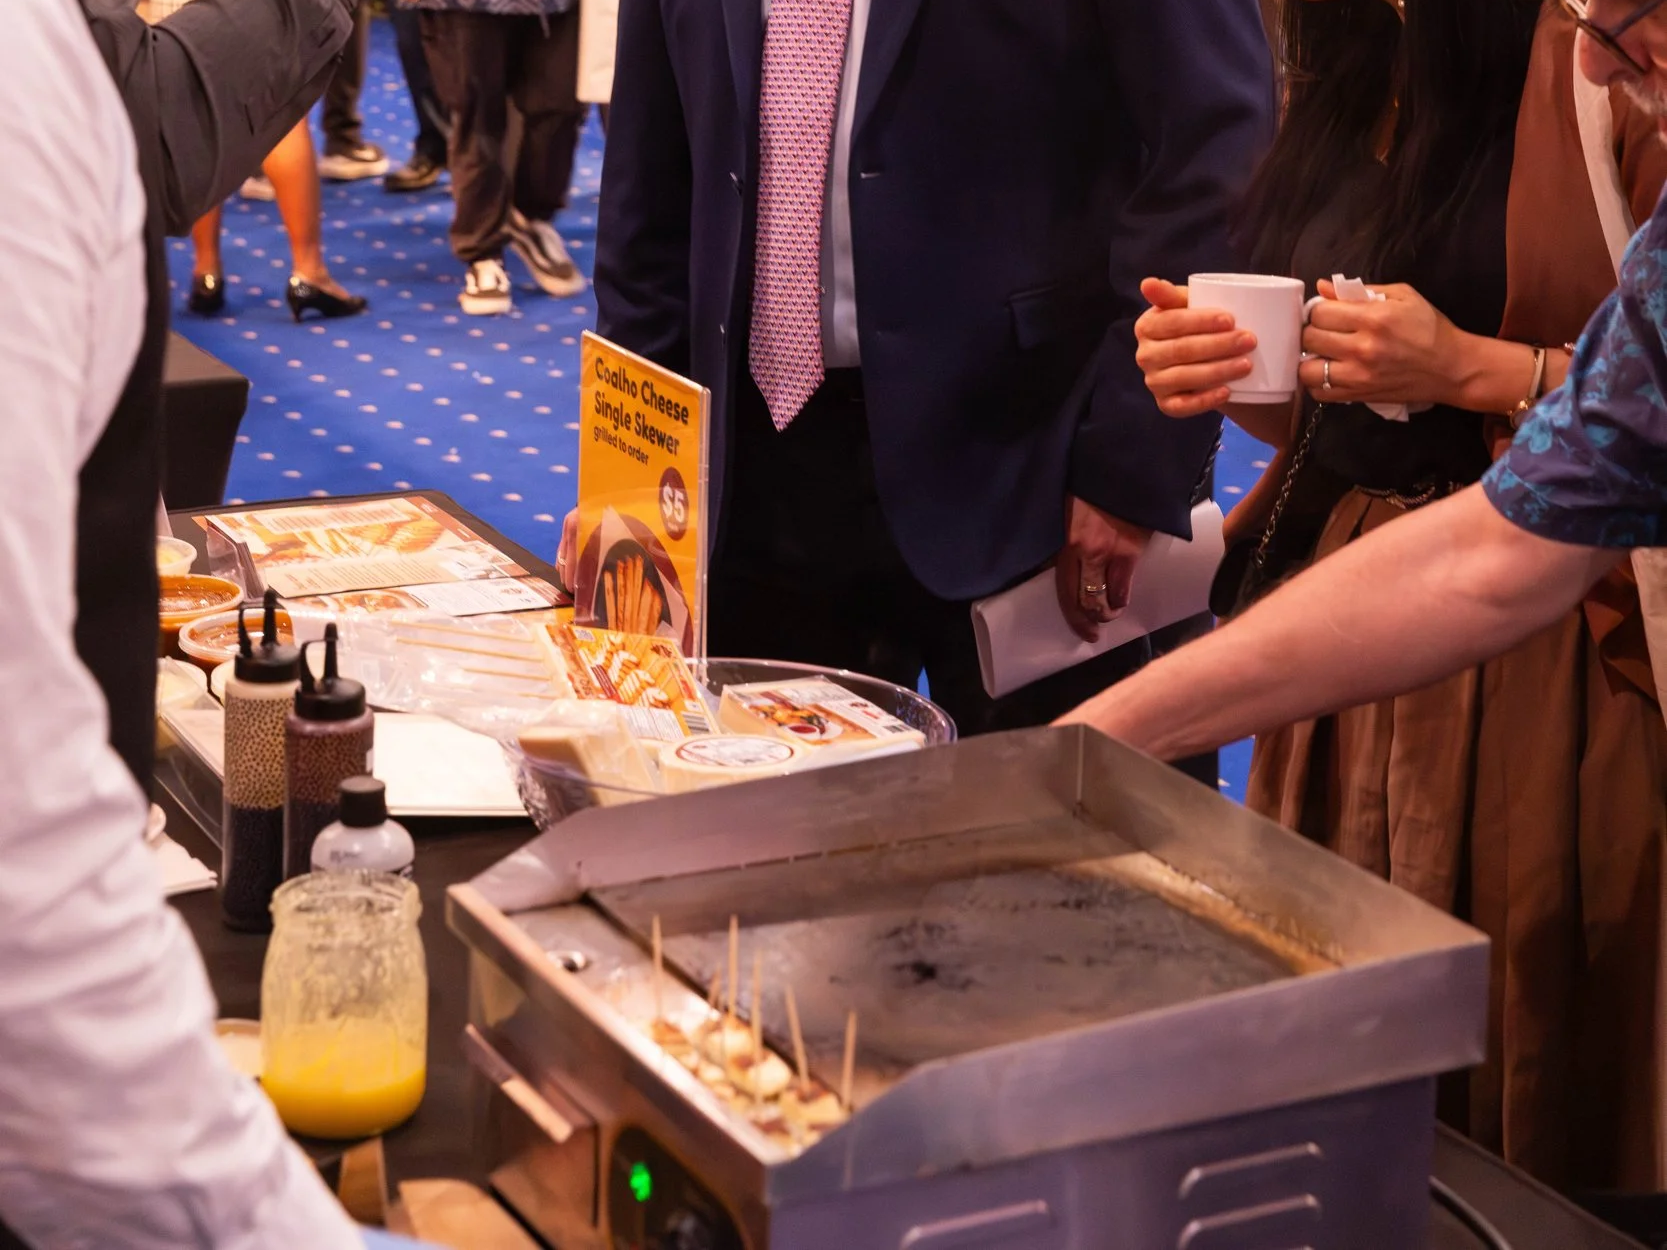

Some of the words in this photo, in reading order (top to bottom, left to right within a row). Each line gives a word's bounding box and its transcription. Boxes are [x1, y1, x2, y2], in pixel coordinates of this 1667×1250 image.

[595, 356, 638, 399] Coalho
[641, 380, 689, 426] Cheese
[593, 425, 618, 449] grilled
[618, 437, 627, 453] to
[627, 444, 649, 466] order
[594, 390, 632, 431] Single
[634, 411, 680, 457] Skewer
[662, 481, 685, 523] $5
